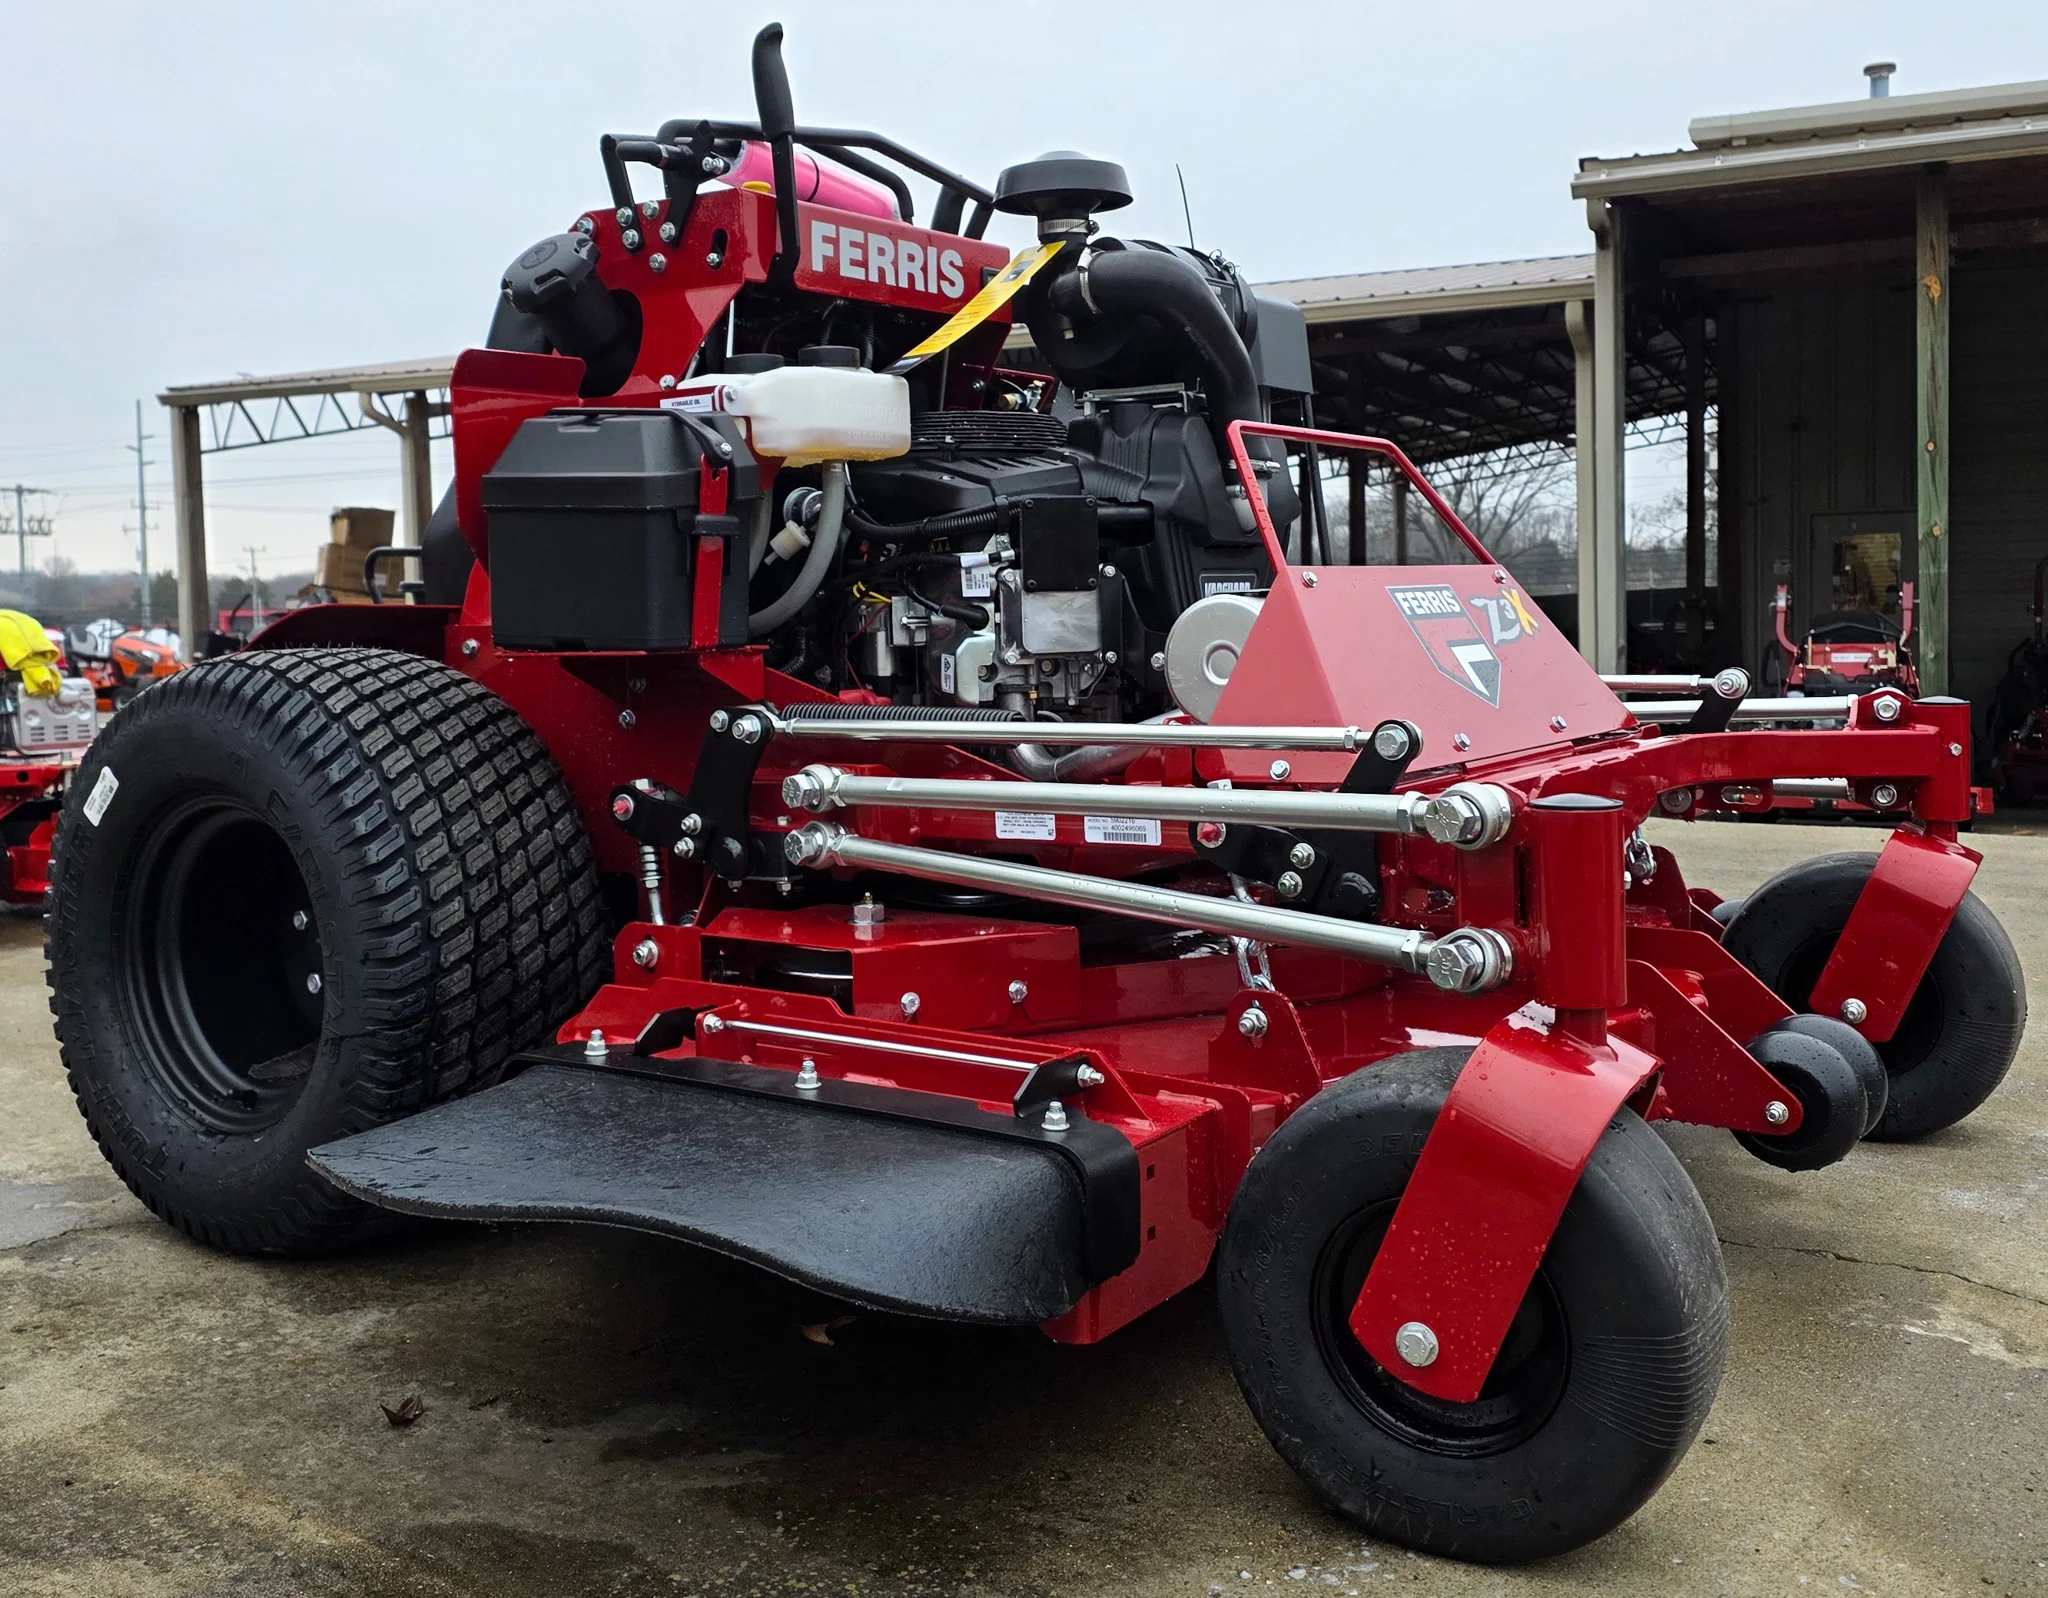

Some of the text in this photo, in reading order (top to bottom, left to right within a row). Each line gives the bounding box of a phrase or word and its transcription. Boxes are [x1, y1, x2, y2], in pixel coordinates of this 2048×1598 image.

[811, 220, 965, 299] FERRIS
[1394, 589, 1461, 616] FERRIS
[83, 1073, 170, 1182] TURF
